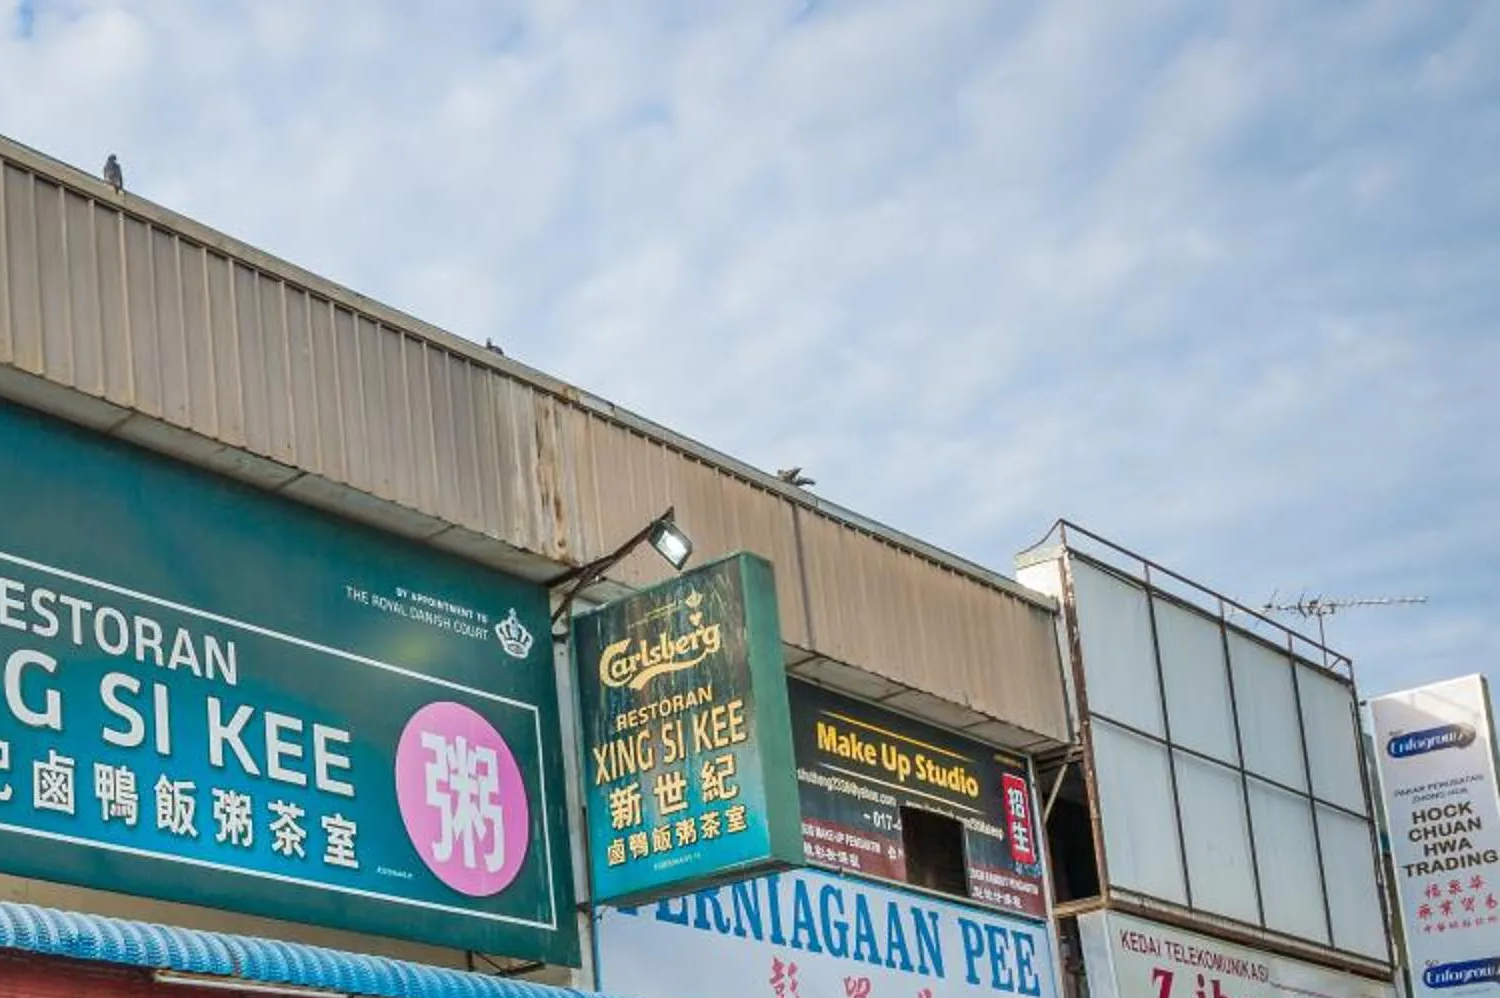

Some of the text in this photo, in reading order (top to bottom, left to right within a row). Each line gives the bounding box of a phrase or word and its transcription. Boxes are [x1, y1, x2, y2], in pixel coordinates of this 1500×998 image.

[346, 585, 488, 641] THE ROYAL DANISH COURT
[600, 622, 722, 690] Carlsberg
[102, 672, 171, 756] SI
[206, 696, 357, 798] KEE
[616, 685, 714, 733] RESTORAN
[593, 699, 748, 786] XING SI KEE
[817, 721, 877, 765] Make
[881, 743, 911, 781] Up
[915, 753, 979, 797] Studio
[422, 732, 504, 874] 粥
[609, 753, 740, 830] 新世紀
[1412, 801, 1473, 824] HOCK
[1408, 816, 1482, 842] CHUAN
[1424, 838, 1473, 857] HWA
[1402, 849, 1499, 878] TRADING
[618, 872, 1041, 998] RNIAGAAN PEE
[1119, 928, 1161, 958] KEDAI
